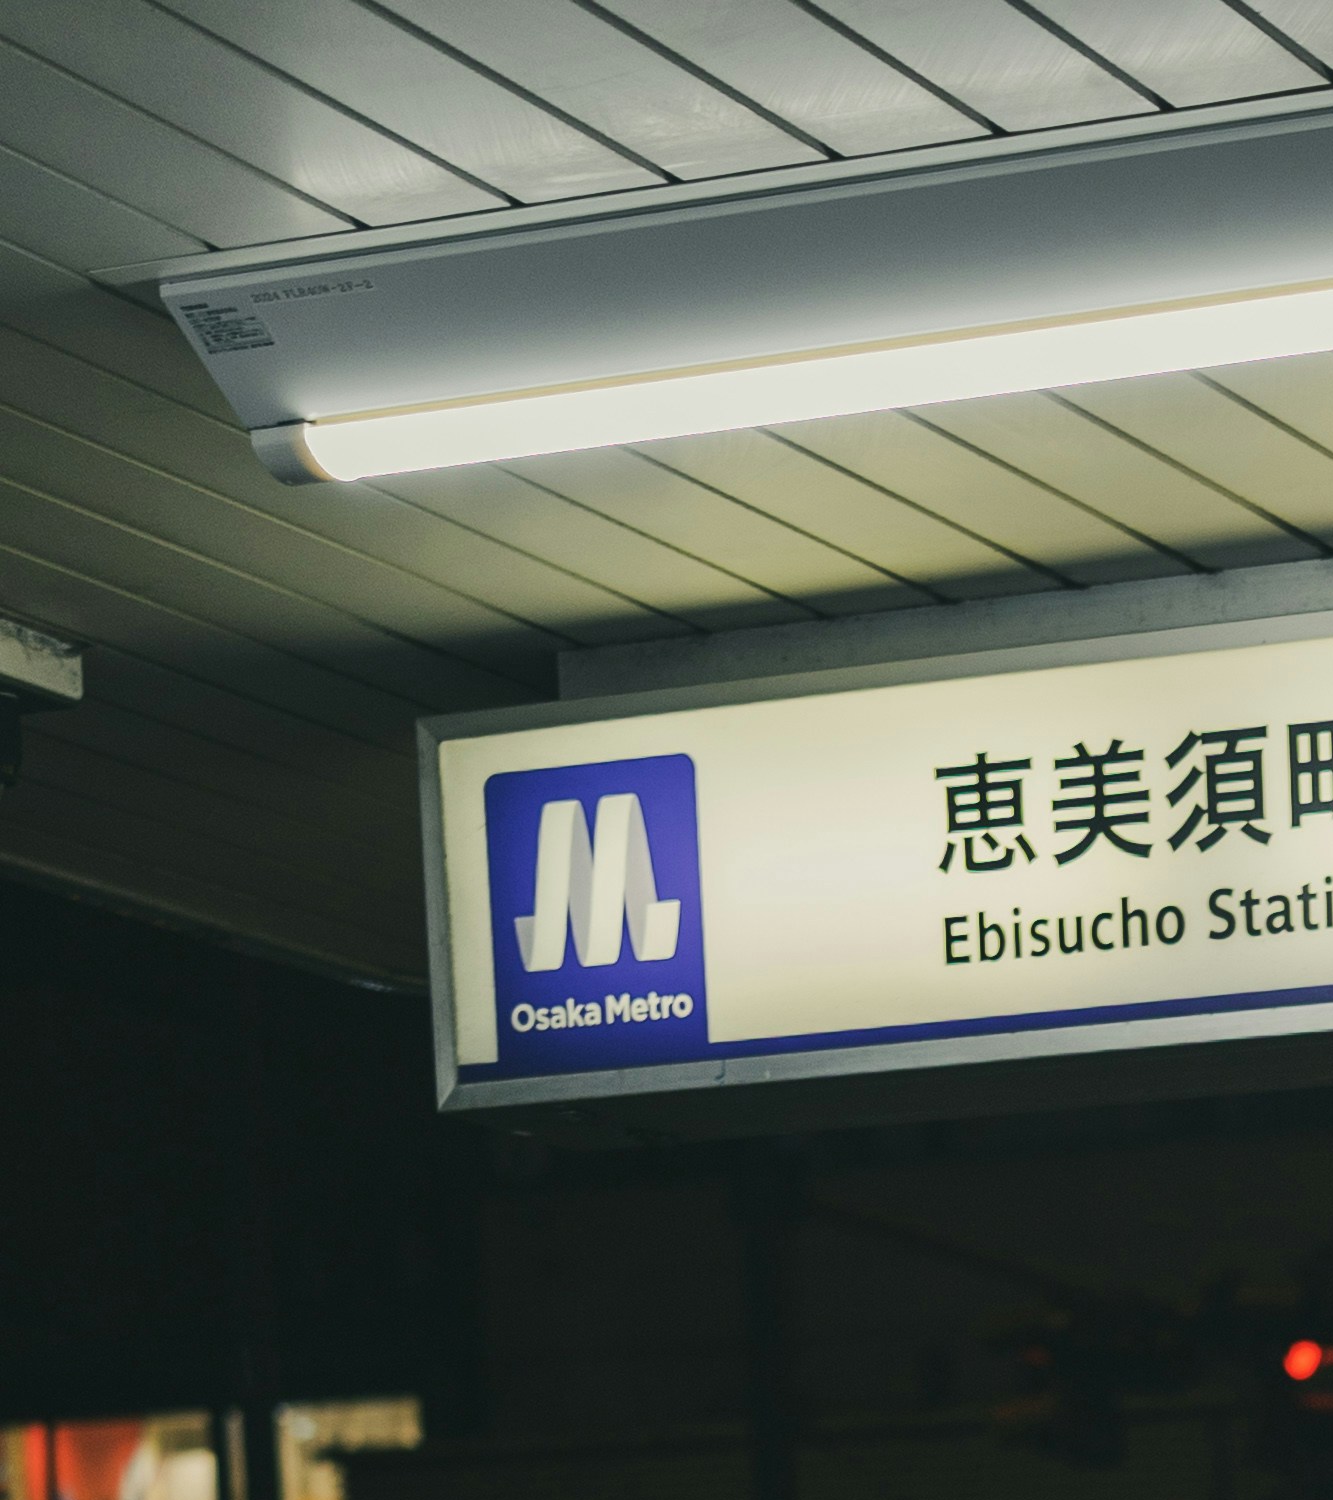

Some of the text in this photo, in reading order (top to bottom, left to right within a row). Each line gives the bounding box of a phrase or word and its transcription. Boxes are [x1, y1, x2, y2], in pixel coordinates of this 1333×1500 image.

[944, 897, 1186, 965] Ebisucho
[511, 991, 694, 1032] Osaka Metro
